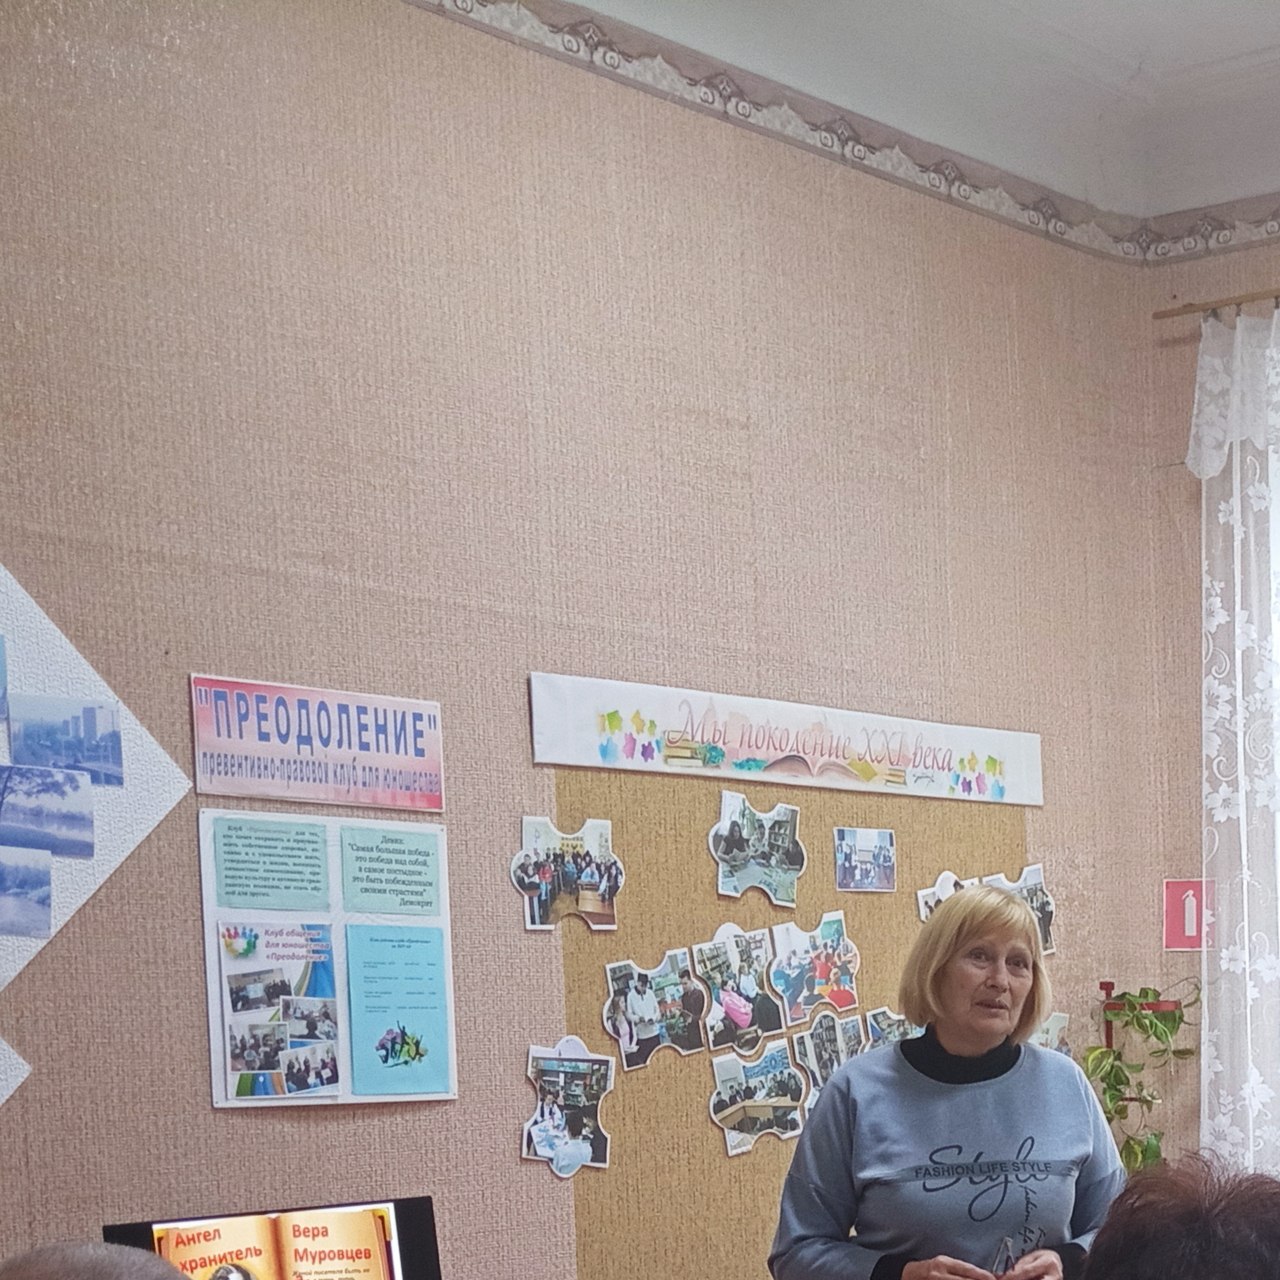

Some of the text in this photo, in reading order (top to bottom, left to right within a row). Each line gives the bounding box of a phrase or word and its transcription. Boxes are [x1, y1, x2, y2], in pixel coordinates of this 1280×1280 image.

[197, 688, 437, 757] "ПРЕОДОЛЕНИЕ"
[666, 699, 954, 772] Мы поколение XXI века
[202, 752, 438, 794] превентивно-правовой клуб для юношества
[264, 929, 284, 938] Клуб
[915, 1161, 1053, 1179] FASHION LIFE STYLE
[175, 1228, 222, 1249] Ангел
[292, 1224, 328, 1241] Вера
[179, 1246, 263, 1274] хранитель
[294, 1247, 372, 1266] Муровцев
